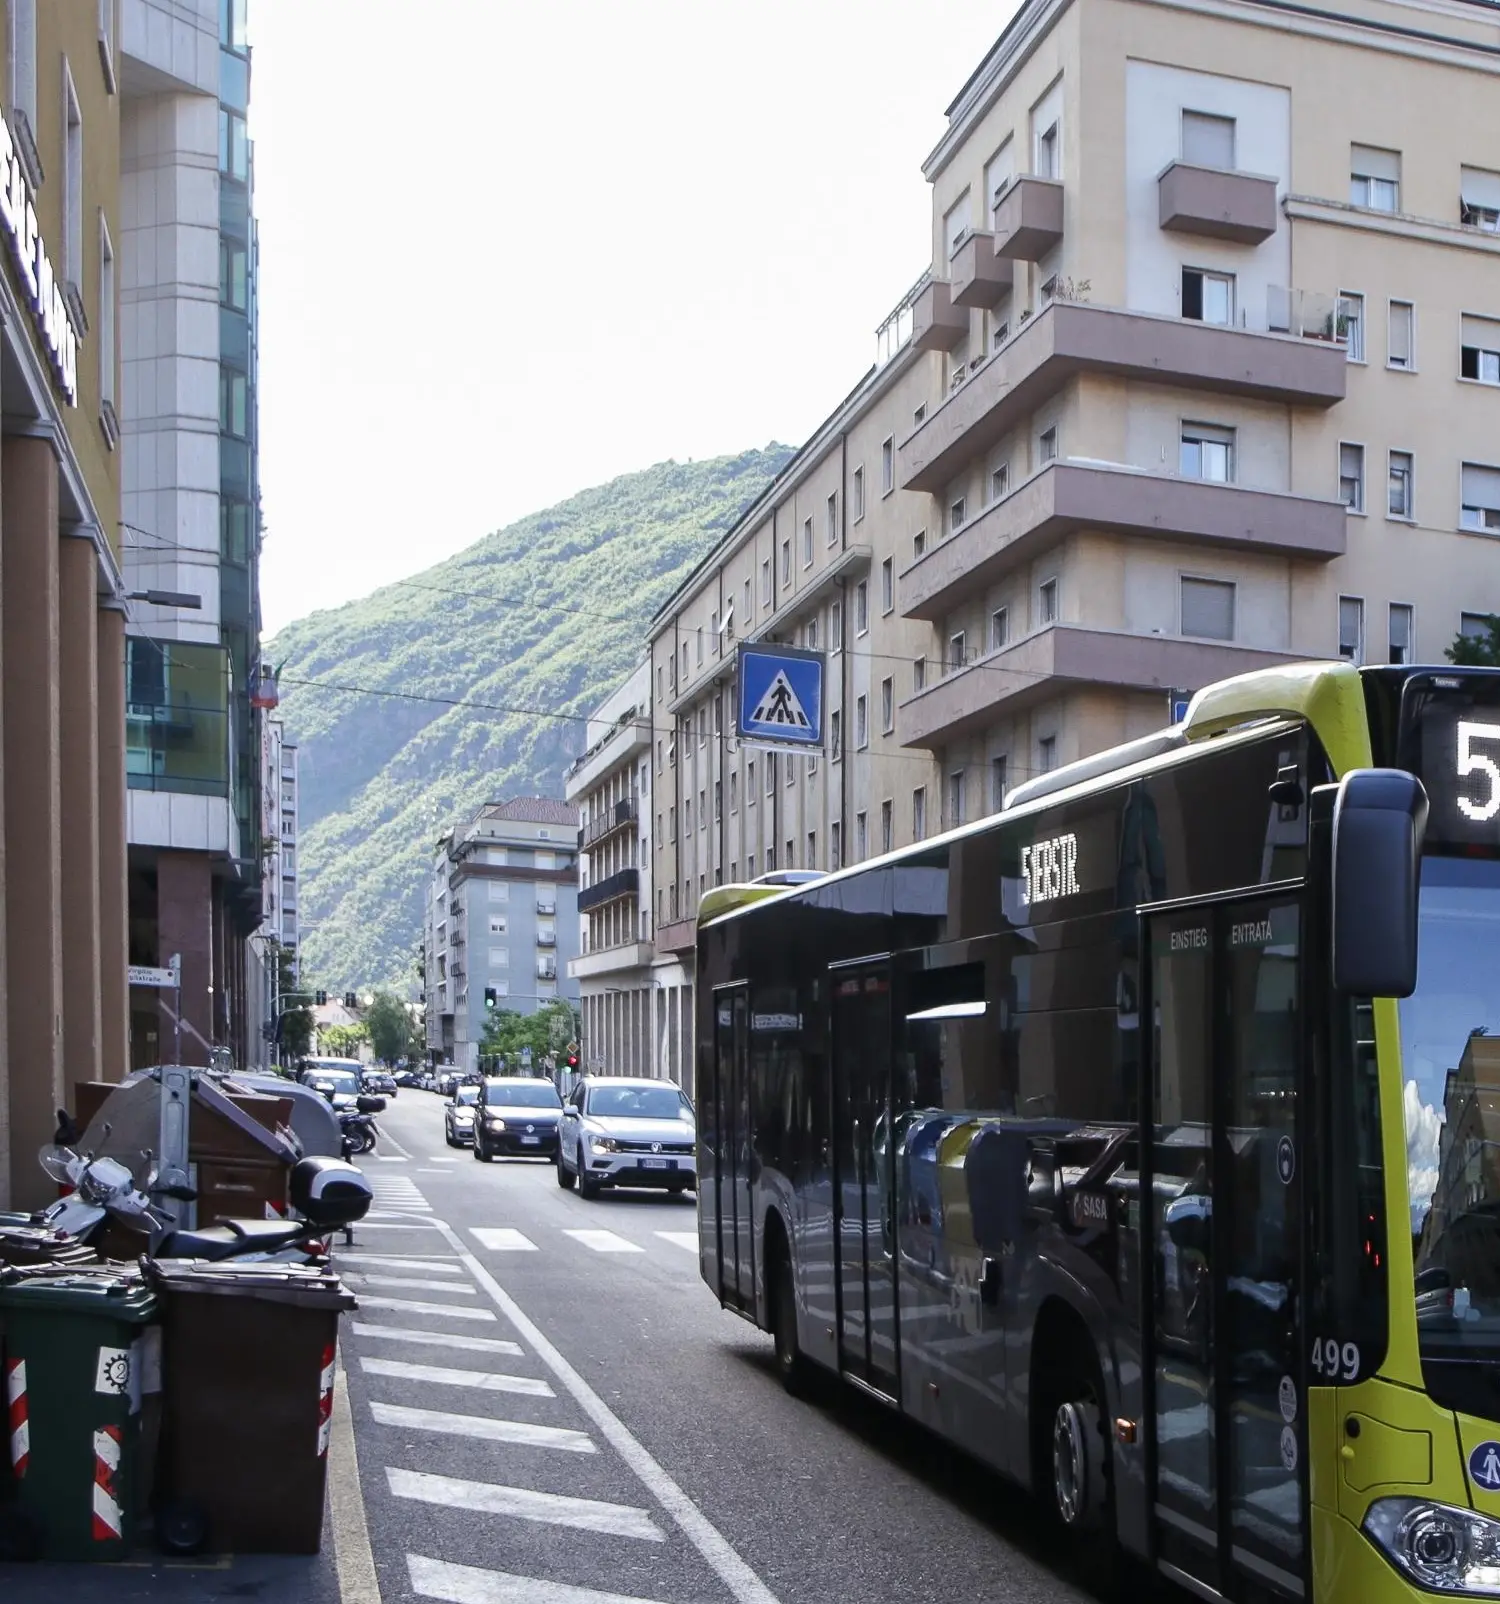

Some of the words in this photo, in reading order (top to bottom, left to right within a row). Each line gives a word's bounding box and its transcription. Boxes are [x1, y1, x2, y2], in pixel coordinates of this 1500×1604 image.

[1171, 927, 1208, 950] EINSTIEG
[1232, 920, 1273, 945] ENTRATA
[1083, 1194, 1108, 1220] SASA
[1311, 1336, 1360, 1380] 499
